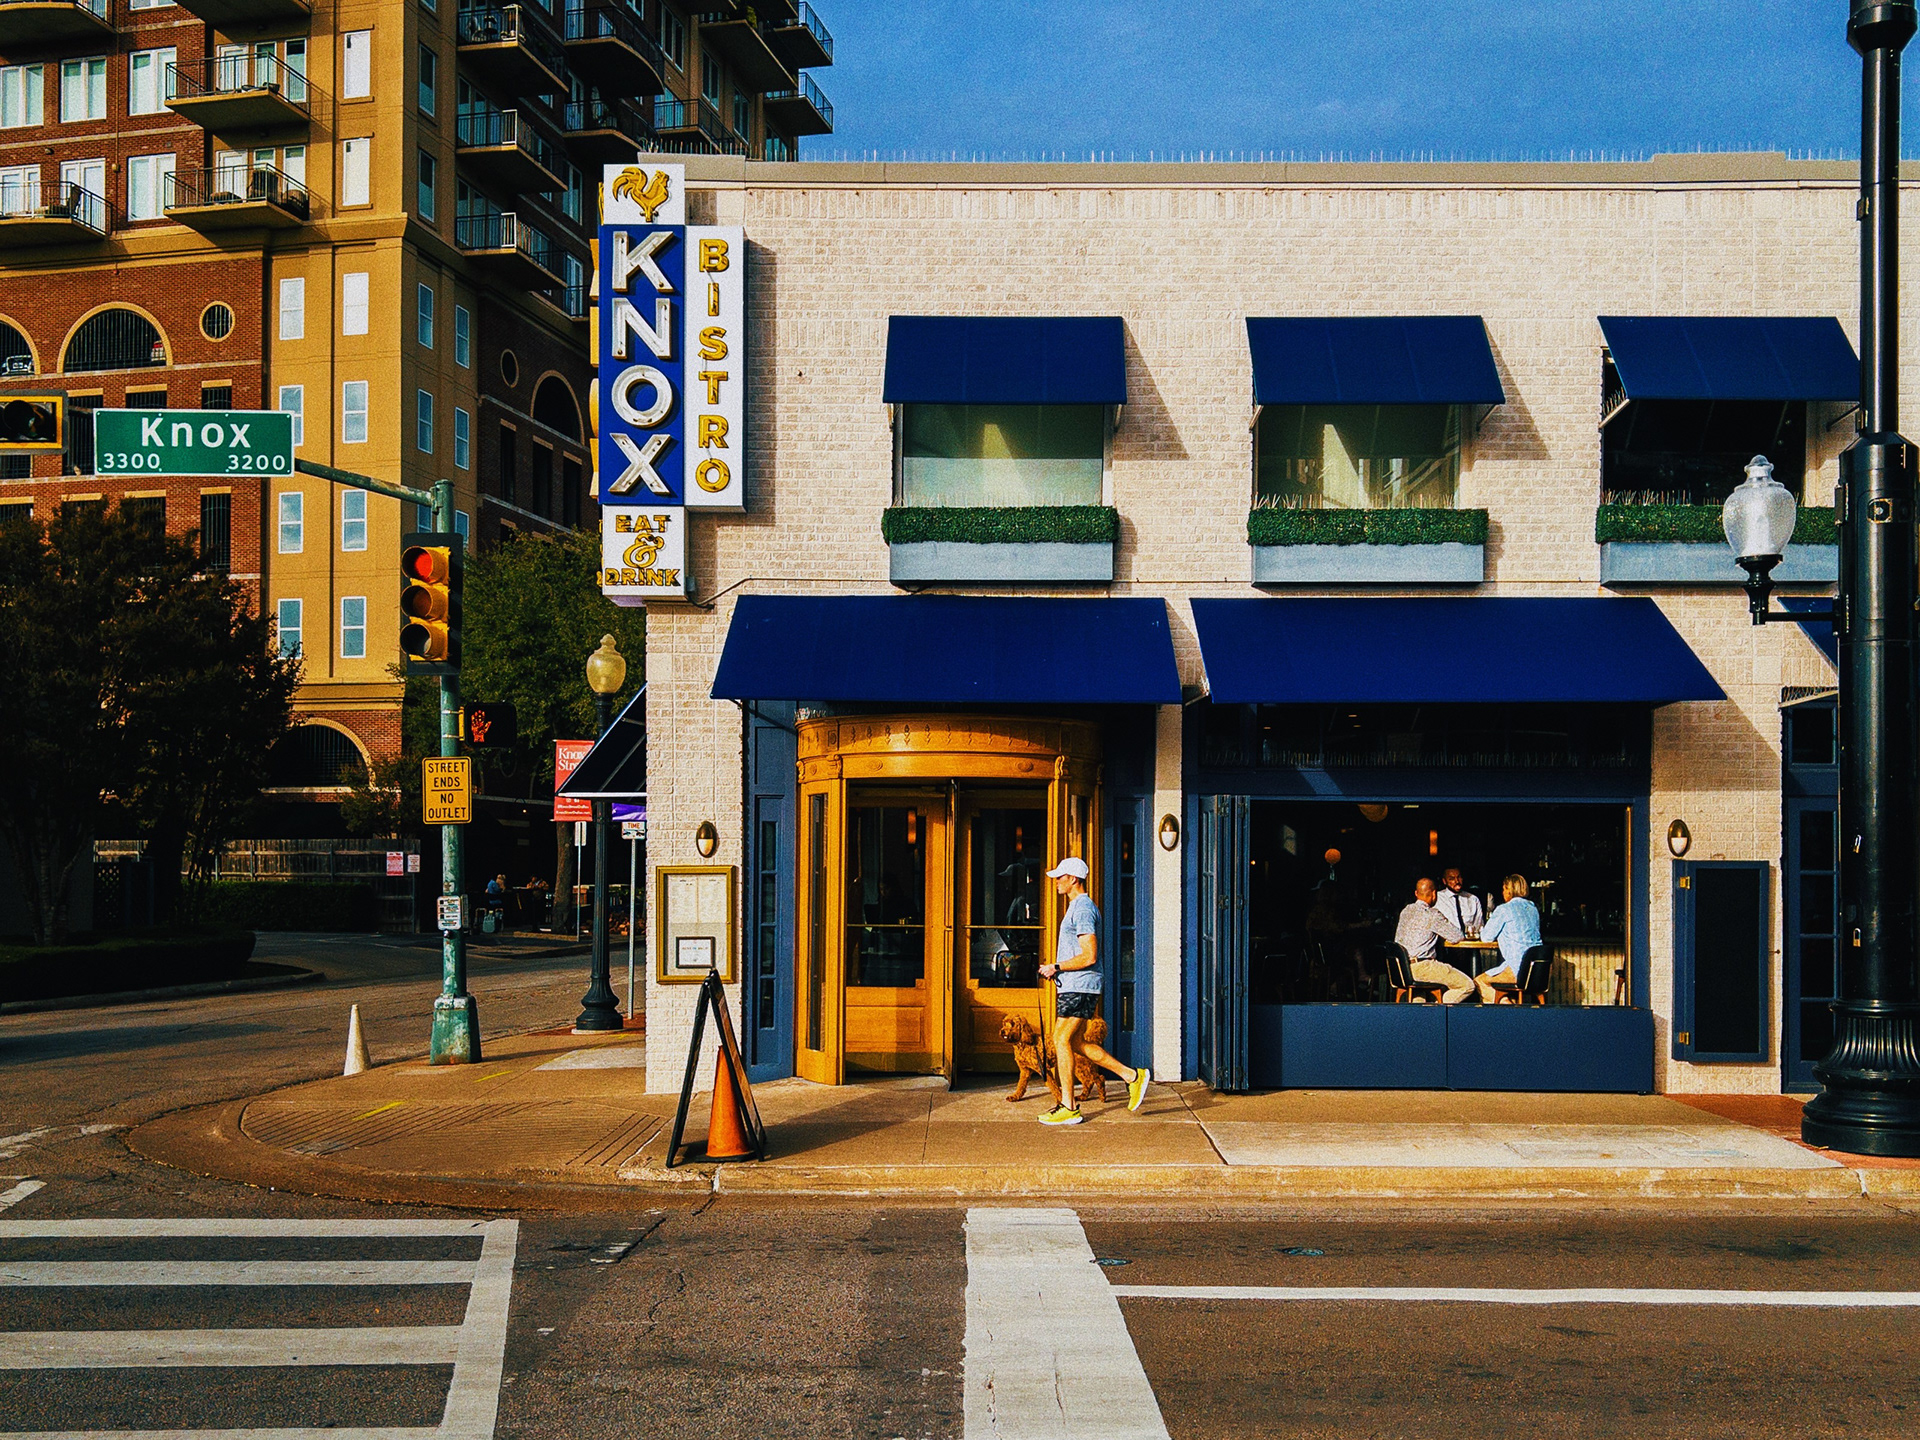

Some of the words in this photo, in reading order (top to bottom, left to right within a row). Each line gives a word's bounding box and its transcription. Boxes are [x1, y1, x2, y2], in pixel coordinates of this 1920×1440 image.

[608, 231, 674, 496] KNOX
[695, 238, 731, 493] BISTRO
[141, 417, 251, 448] Knox
[103, 453, 160, 469] 3300
[228, 454, 286, 470] 3200
[615, 514, 672, 533] EAT
[622, 532, 664, 569] &
[605, 567, 681, 586] DRINK
[428, 761, 466, 773] STREET
[433, 776, 461, 788] ENDS
[440, 792, 454, 804] NO
[428, 807, 467, 819] OUTLET
